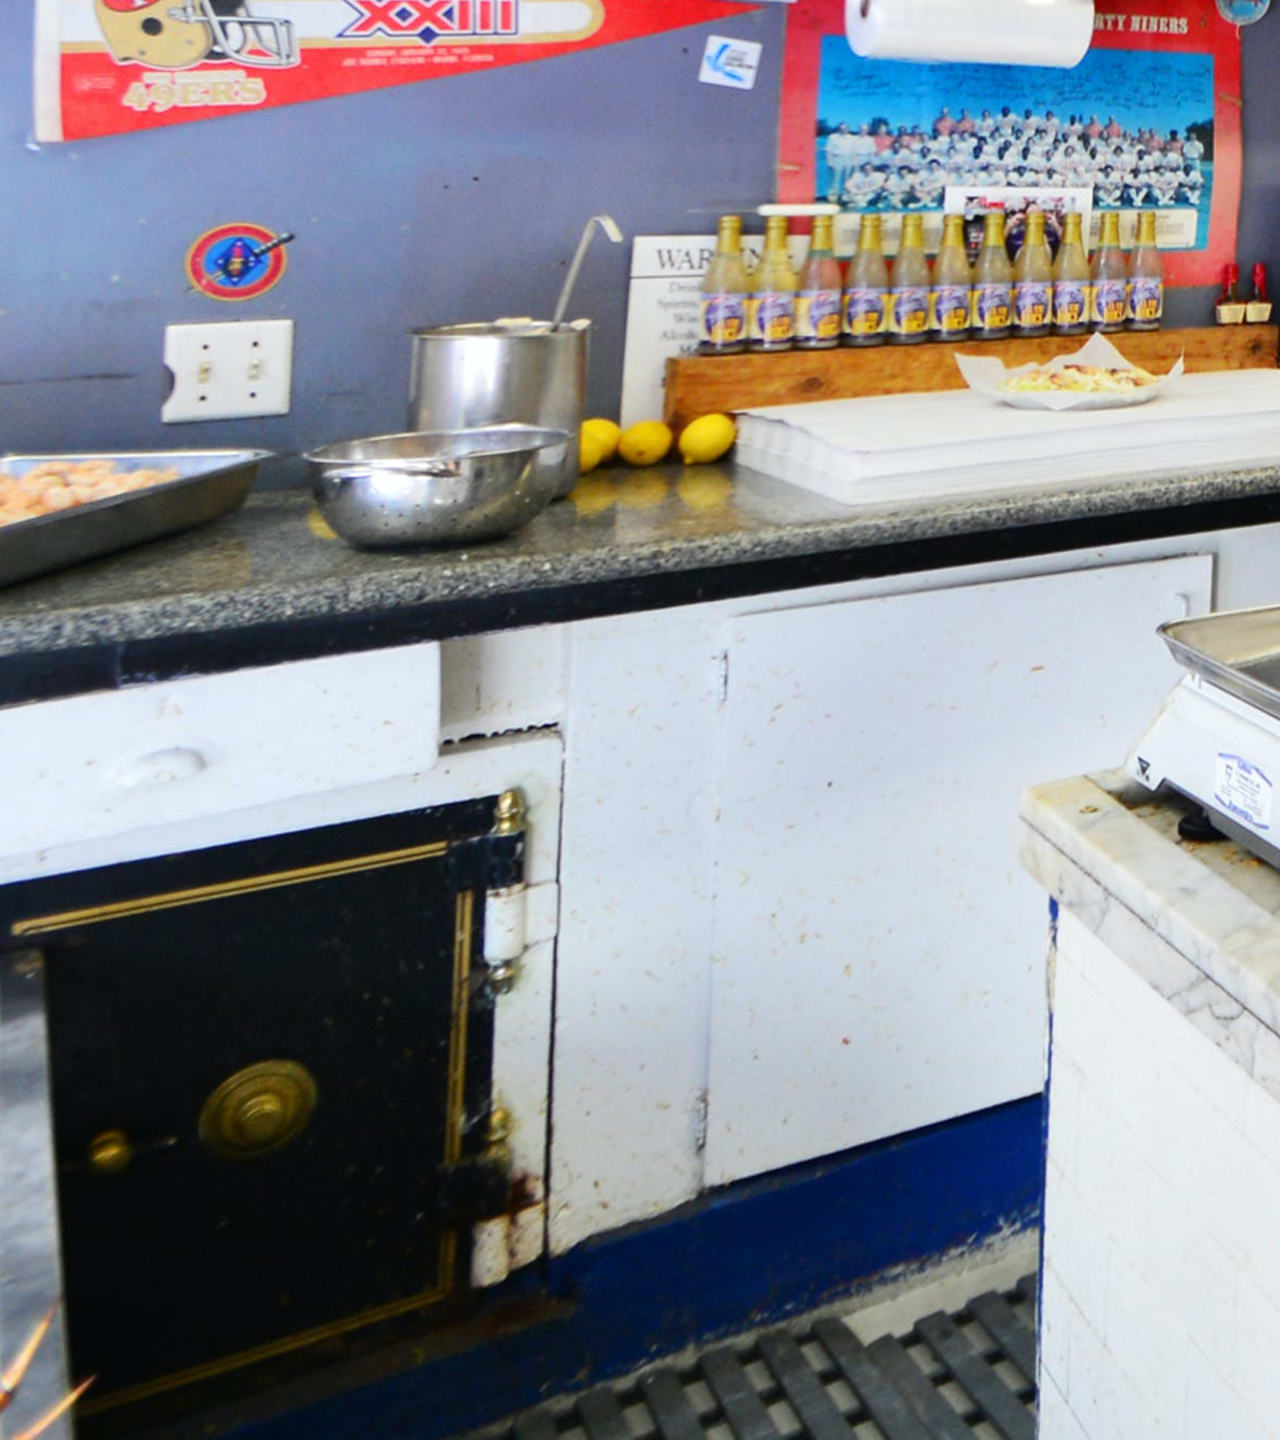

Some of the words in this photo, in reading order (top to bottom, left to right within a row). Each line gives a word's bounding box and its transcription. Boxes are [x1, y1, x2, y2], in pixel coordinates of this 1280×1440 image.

[1092, 13, 1128, 32] RTY
[1130, 14, 1189, 35] NINERS
[121, 76, 268, 113] 49ERS
